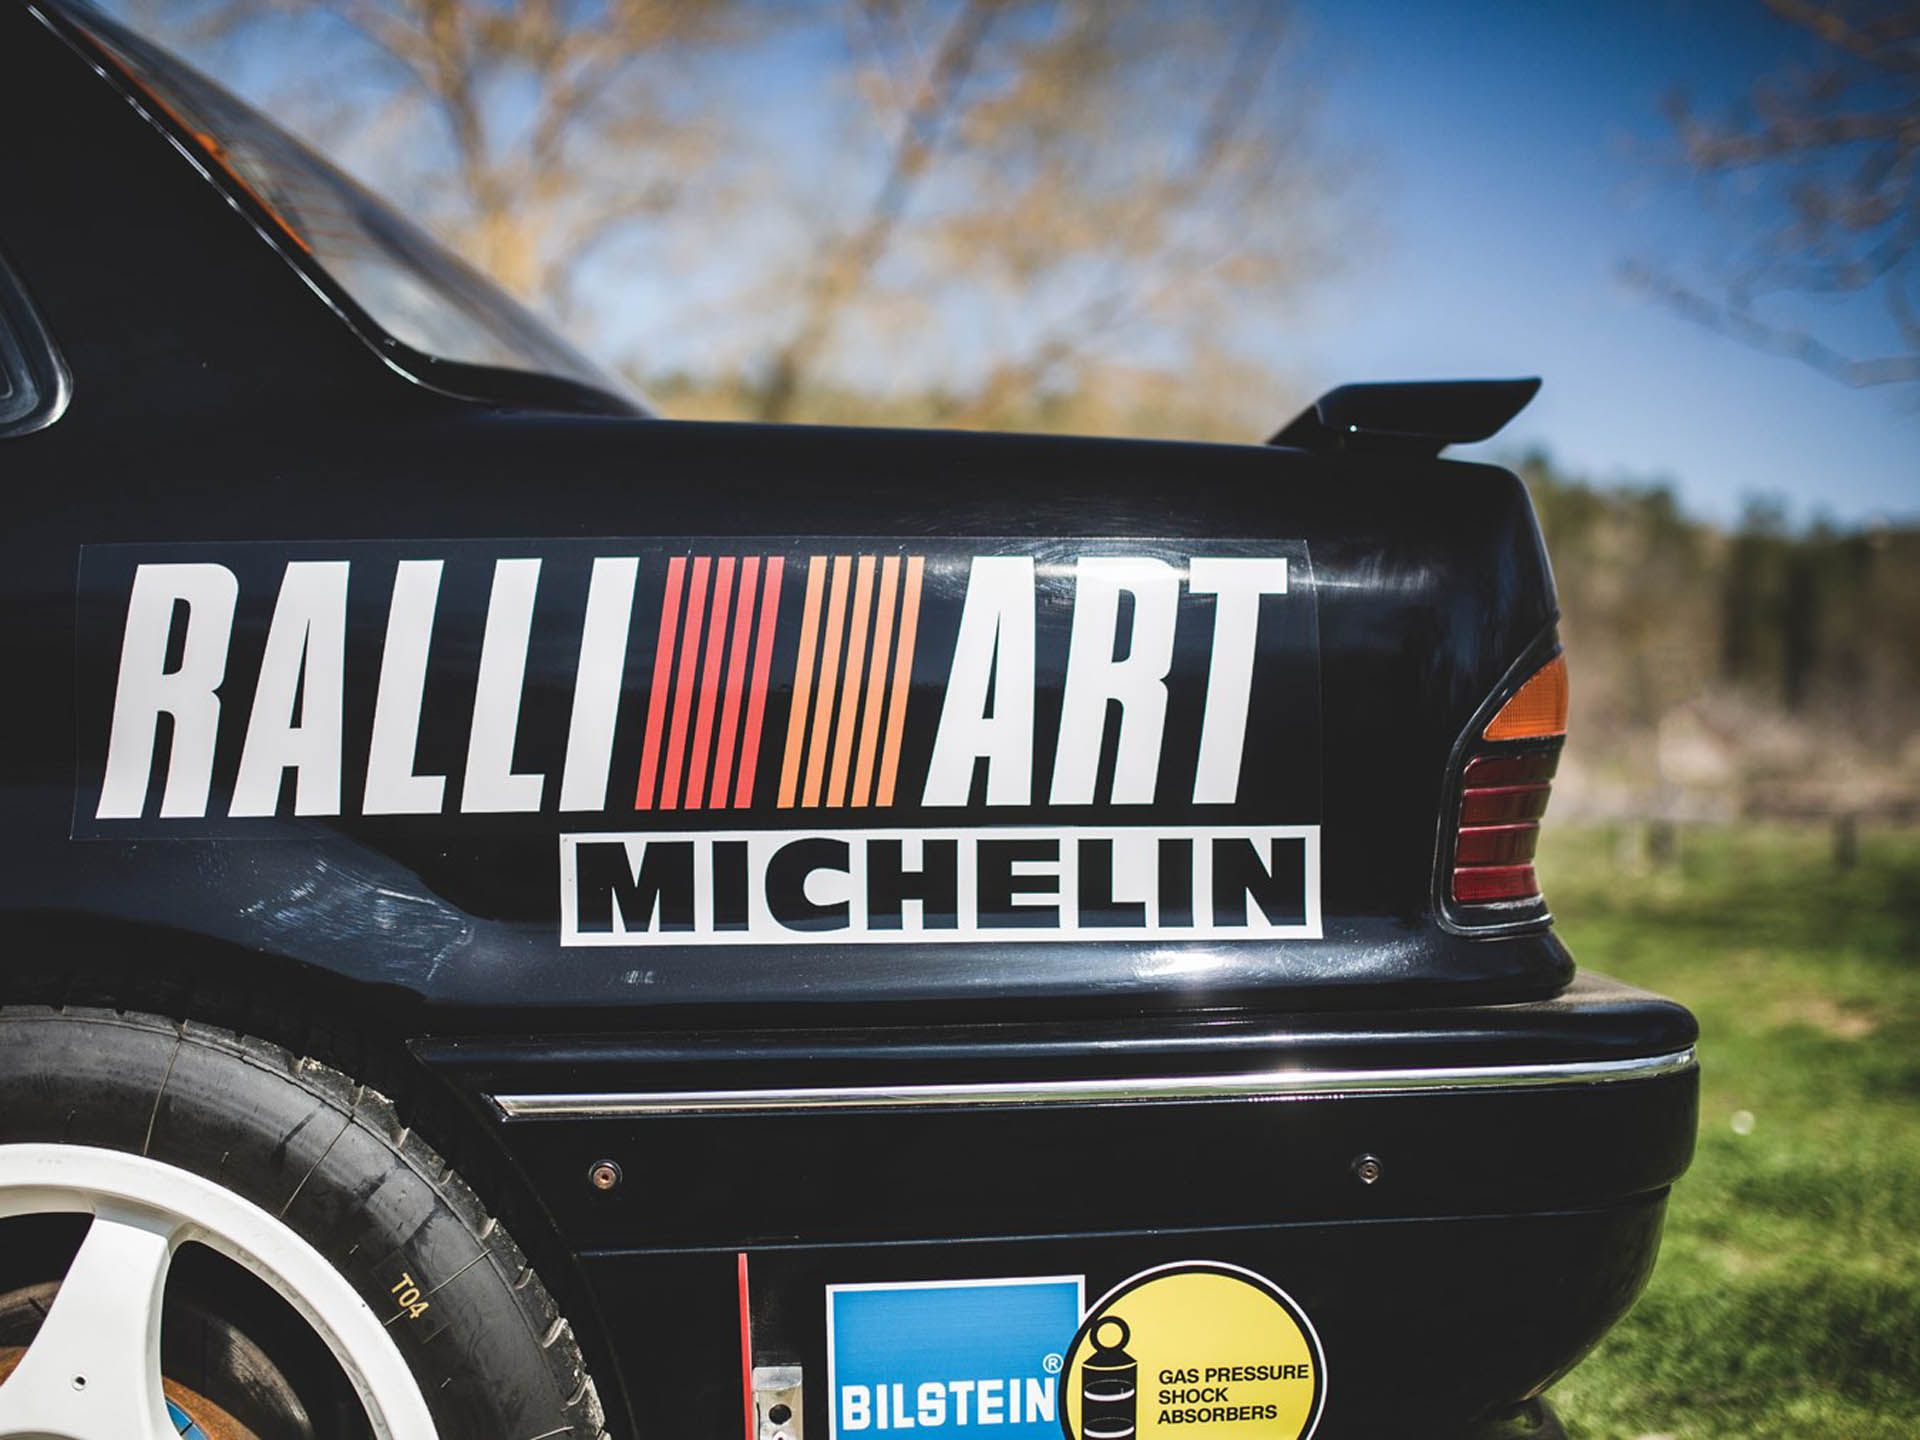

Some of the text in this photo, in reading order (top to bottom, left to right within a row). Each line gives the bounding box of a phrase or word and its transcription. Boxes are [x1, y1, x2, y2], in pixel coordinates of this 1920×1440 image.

[575, 837, 1307, 933] MICHELIN
[391, 1272, 430, 1319] T04
[1158, 1364, 1310, 1385] GAS PRESSURE
[1158, 1387, 1229, 1405] SHOCK
[1157, 1404, 1278, 1425] ABSORBERS
